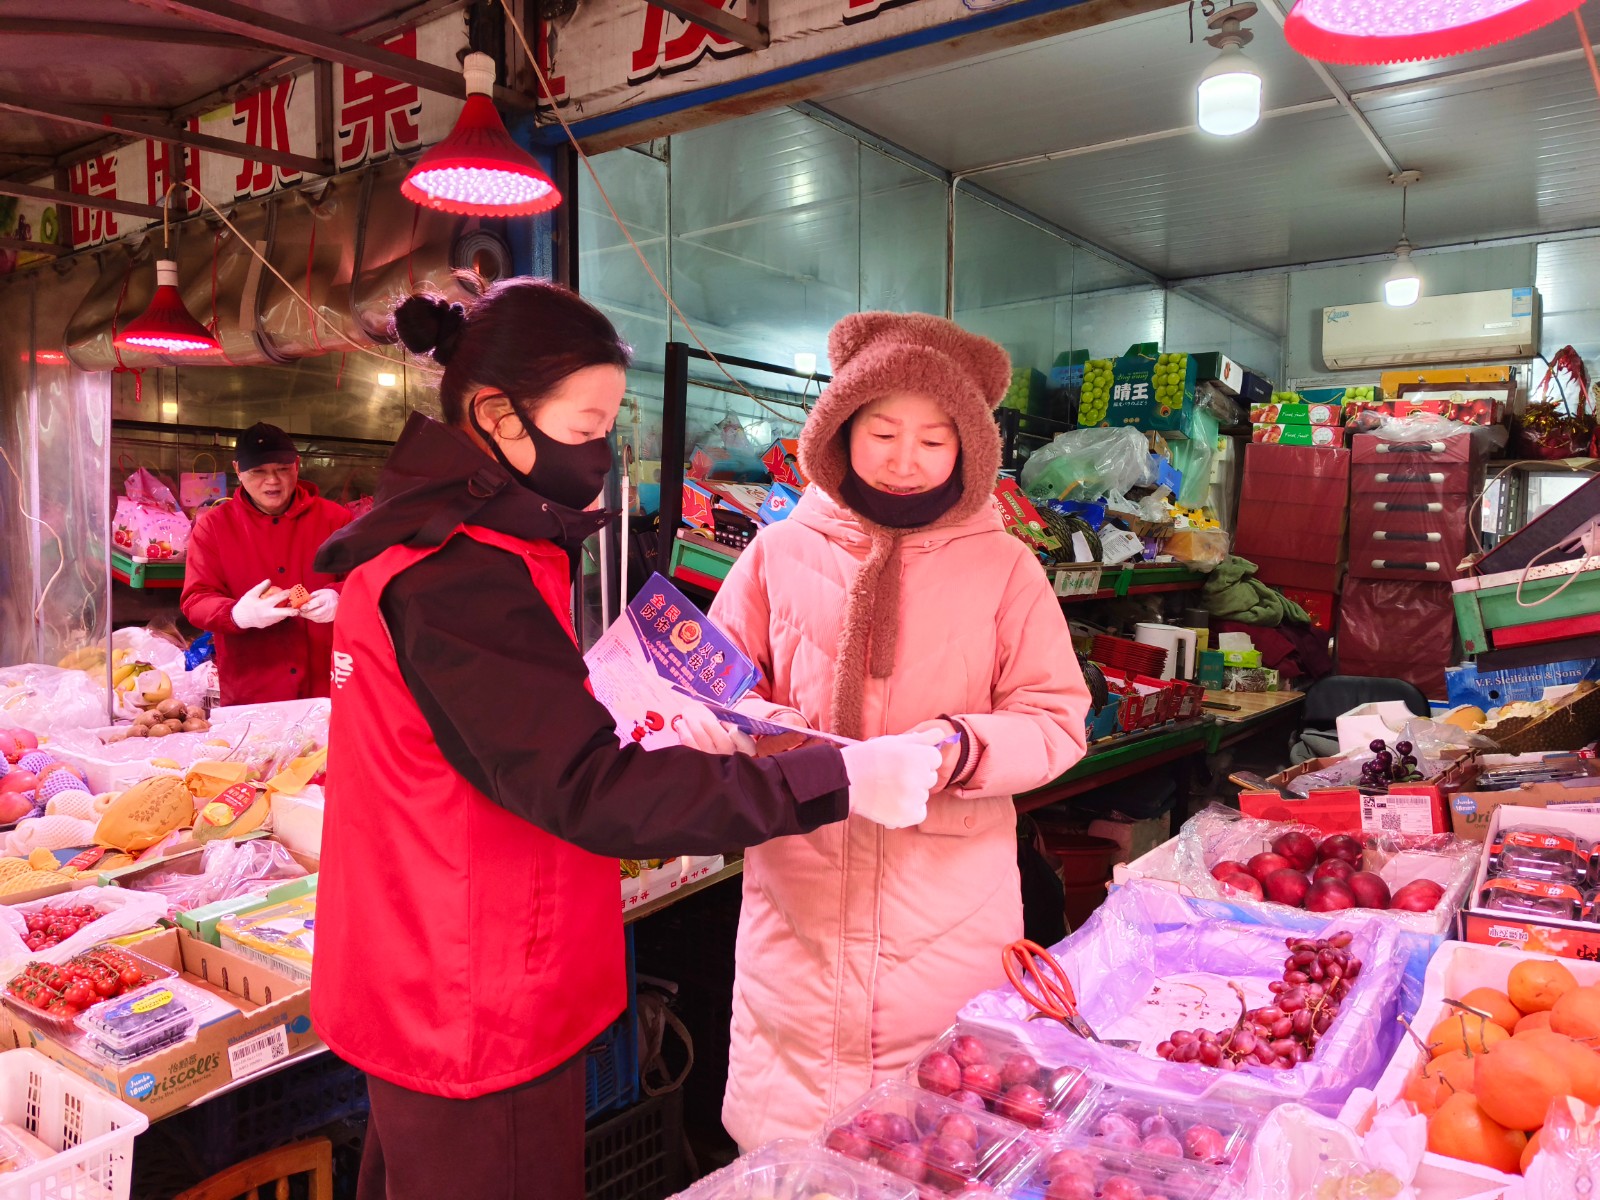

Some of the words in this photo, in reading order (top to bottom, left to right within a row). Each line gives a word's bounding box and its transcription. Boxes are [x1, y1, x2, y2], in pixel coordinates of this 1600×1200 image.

[1113, 382, 1149, 401] 晴王
[650, 593, 682, 623] 全民
[640, 604, 671, 634] 防诈
[1475, 678, 1493, 688] V.F.
[1495, 673, 1542, 686] Siciliano
[1545, 671, 1553, 679] &
[1555, 668, 1583, 678] Sons
[228, 1020, 271, 1045] Blueberries
[129, 1074, 151, 1089] Jumbo
[129, 1079, 155, 1097] 18mm+
